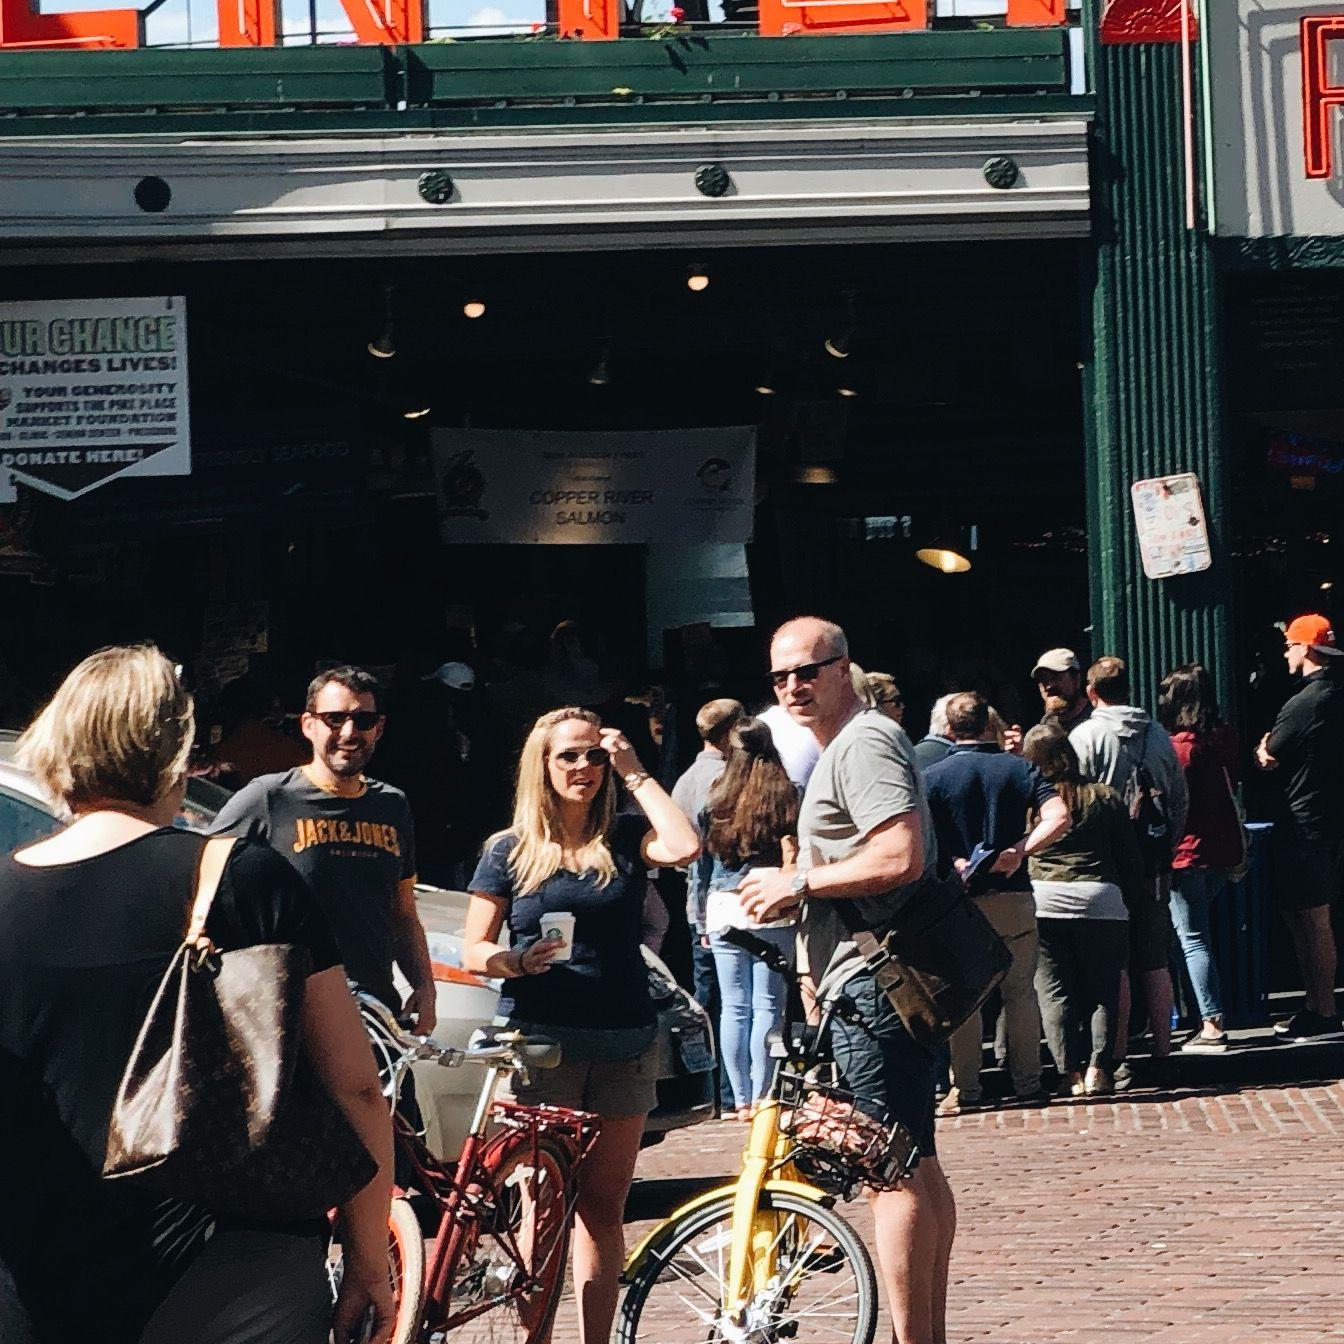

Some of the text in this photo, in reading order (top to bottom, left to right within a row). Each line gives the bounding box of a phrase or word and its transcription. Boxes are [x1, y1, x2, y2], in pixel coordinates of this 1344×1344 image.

[48, 315, 177, 356] CHANGE
[1, 451, 82, 466] DONATE
[529, 489, 656, 506] COPPER RIVER
[555, 510, 626, 526] SALMON
